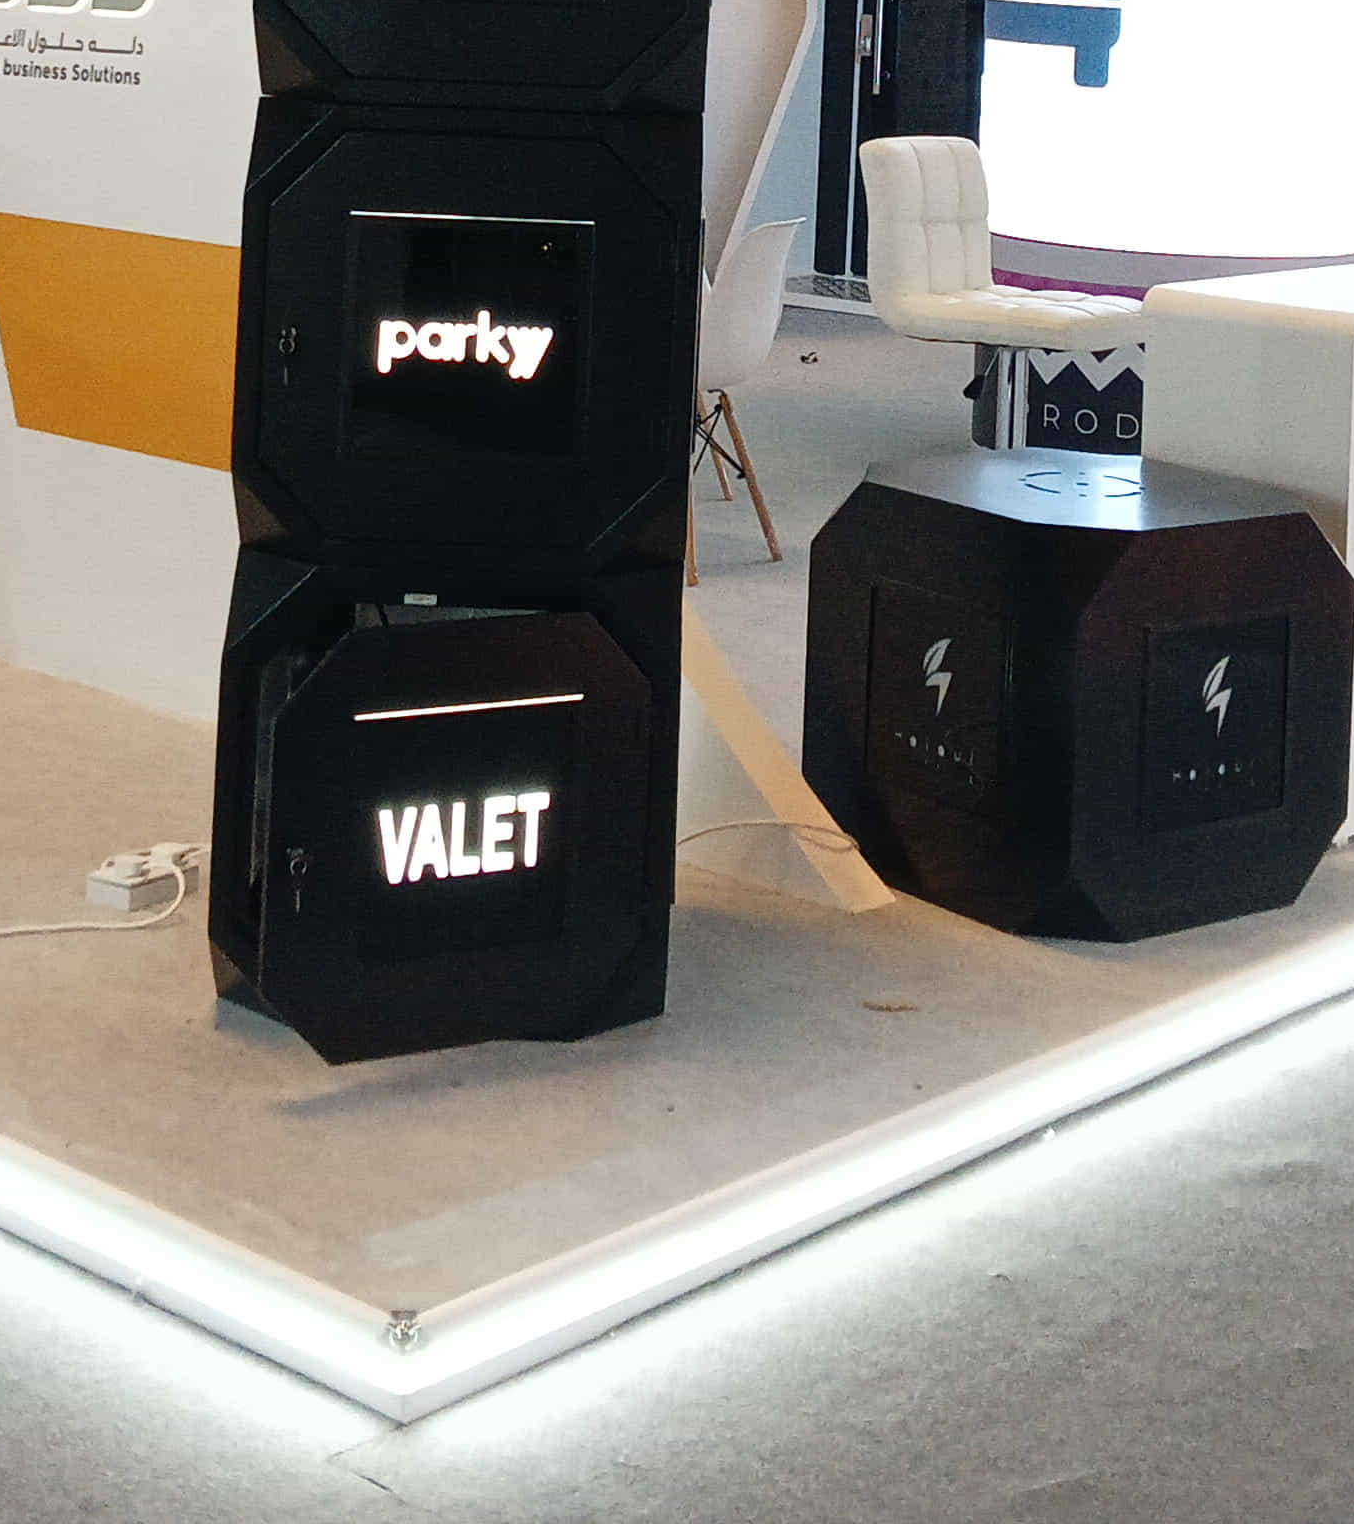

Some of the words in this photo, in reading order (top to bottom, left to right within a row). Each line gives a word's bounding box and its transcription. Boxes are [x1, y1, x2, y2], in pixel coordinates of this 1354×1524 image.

[3, 60, 67, 80] business
[72, 64, 141, 85] Solutions
[376, 309, 554, 380] parky
[1043, 404, 1140, 439] ROD
[377, 790, 551, 885] VALET
